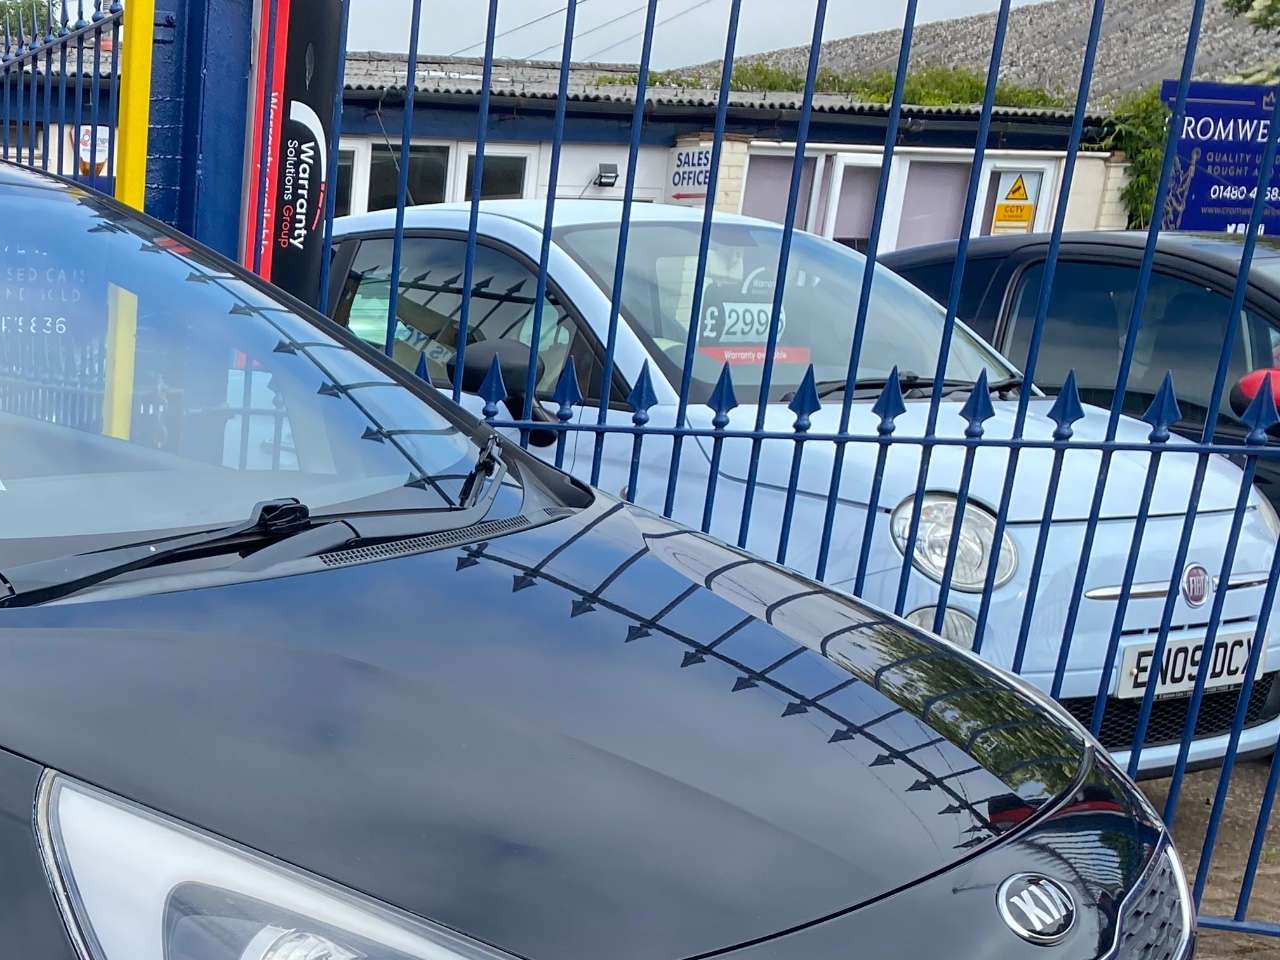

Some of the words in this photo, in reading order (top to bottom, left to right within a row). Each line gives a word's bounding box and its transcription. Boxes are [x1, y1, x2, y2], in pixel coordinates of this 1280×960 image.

[1164, 115, 1280, 143] ROMWE
[284, 139, 298, 201] Solutions
[676, 150, 710, 168] SALES
[1206, 151, 1251, 164] QUALITY
[672, 170, 710, 186] OFFICE
[289, 141, 315, 250] Warranty
[1210, 184, 1247, 200] 01480
[280, 204, 294, 248] Group
[1189, 575, 1206, 597] FIAT
[1009, 879, 1074, 932] KIA
